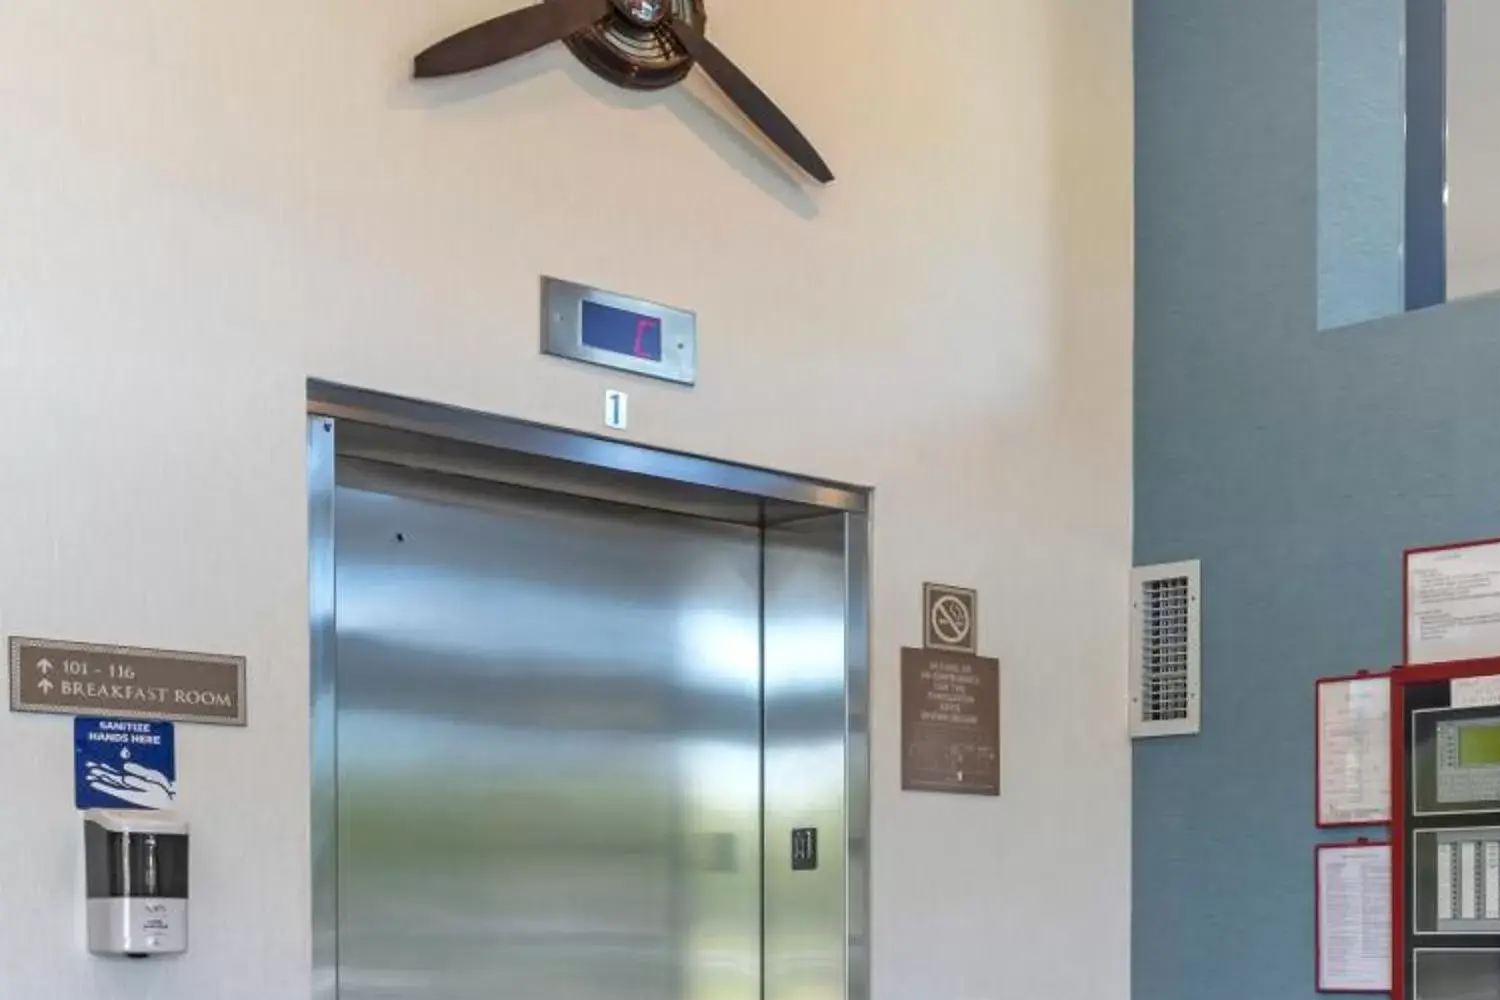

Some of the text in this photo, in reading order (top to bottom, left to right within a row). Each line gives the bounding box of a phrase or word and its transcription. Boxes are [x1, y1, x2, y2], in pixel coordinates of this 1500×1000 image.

[609, 393, 621, 425] 1
[62, 659, 88, 676] 101
[109, 663, 136, 680] 116
[60, 680, 232, 707] BREAKFAST ROOM
[88, 731, 161, 745] HANDS HERE
